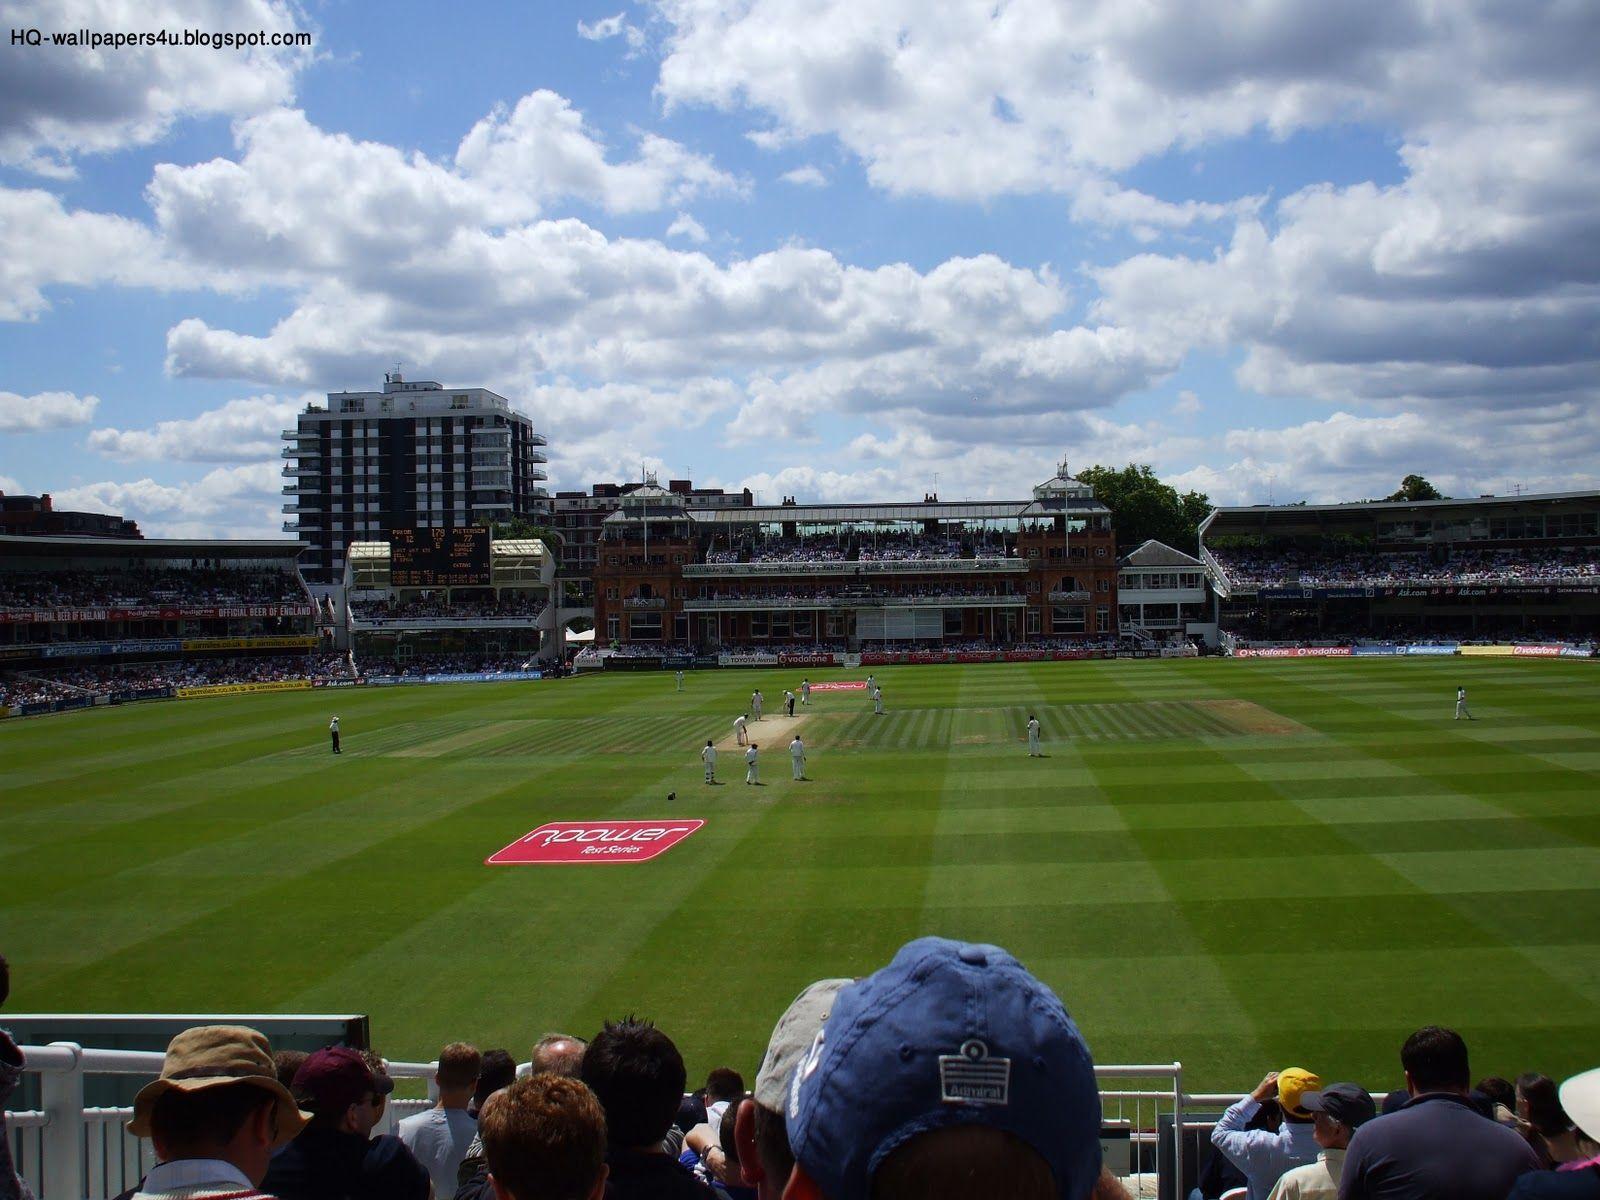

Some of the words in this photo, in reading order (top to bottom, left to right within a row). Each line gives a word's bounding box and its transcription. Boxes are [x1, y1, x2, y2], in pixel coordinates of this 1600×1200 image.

[58, 611, 71, 621] BEER
[80, 610, 106, 621] ENGLAND
[219, 608, 248, 617] OFFICIAL
[250, 608, 268, 617] BEER
[269, 607, 279, 616] OF
[280, 606, 311, 616] ENGLAND
[787, 654, 828, 664] vodafone
[326, 678, 355, 687] Ask.com
[524, 829, 689, 847] npower
[580, 845, 606, 854] Test
[605, 845, 642, 854] Series
[950, 1083, 1002, 1099] Admiral
